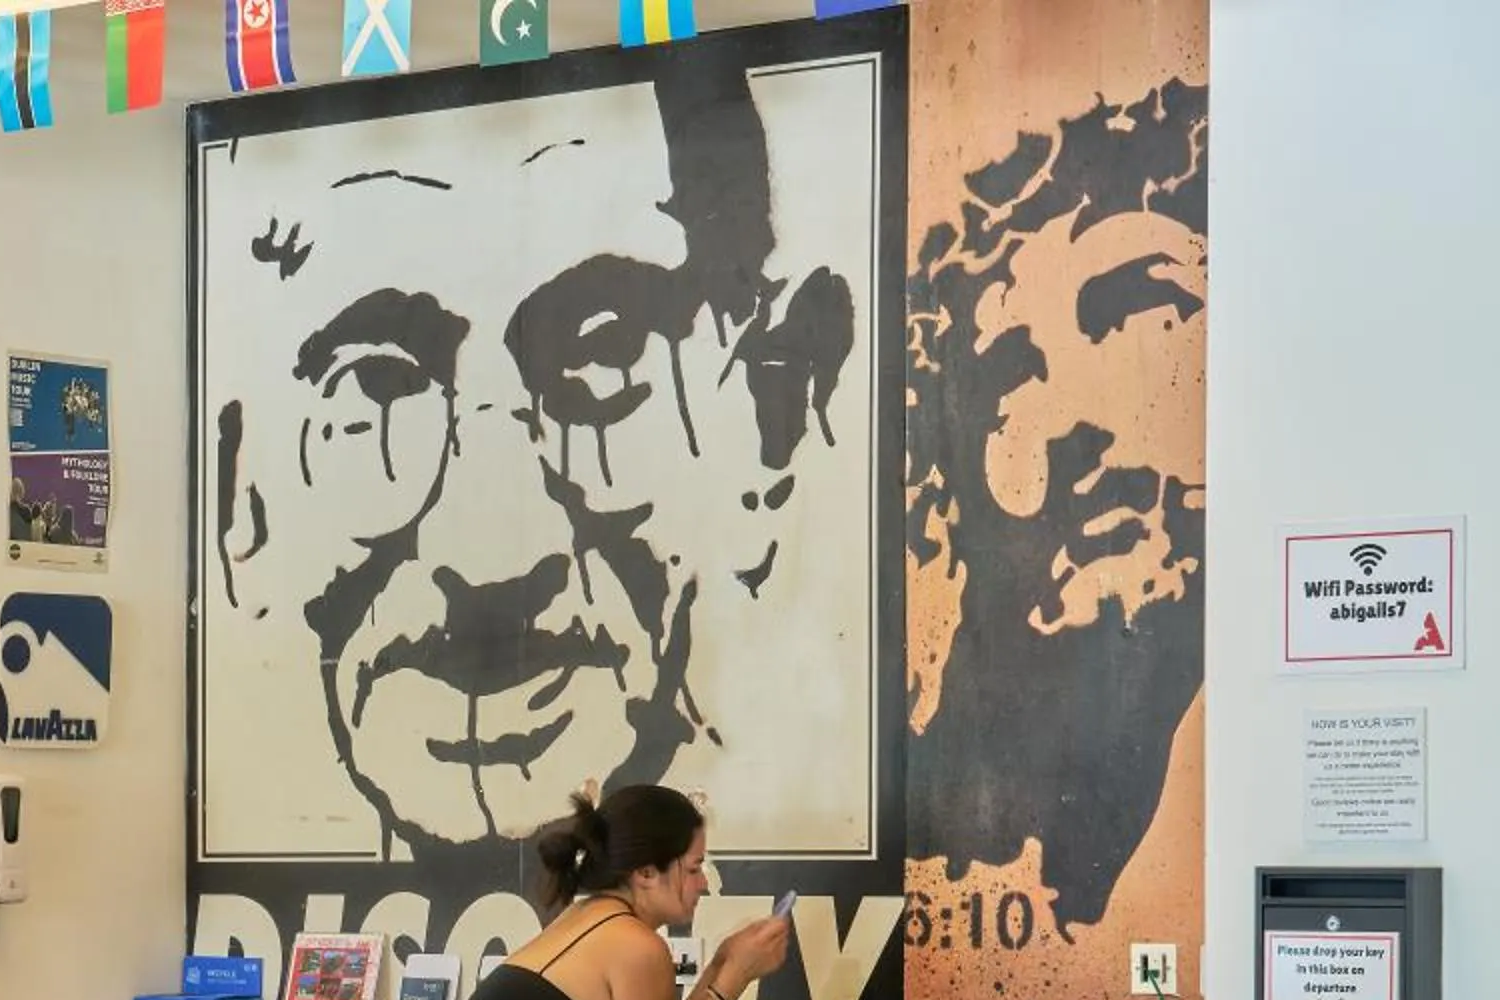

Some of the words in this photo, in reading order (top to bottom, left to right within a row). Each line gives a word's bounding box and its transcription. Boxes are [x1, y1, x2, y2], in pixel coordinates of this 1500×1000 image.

[1304, 580, 1340, 598] Wifi
[1345, 576, 1433, 596] Password:
[1329, 600, 1406, 622] abigails7
[11, 709, 97, 741] LAVAZZA
[1277, 944, 1310, 957] Please
[1312, 944, 1336, 960] drop
[1340, 947, 1363, 960] your
[1365, 946, 1385, 960] key
[1330, 964, 1349, 975] box
[1303, 982, 1357, 994] departure
